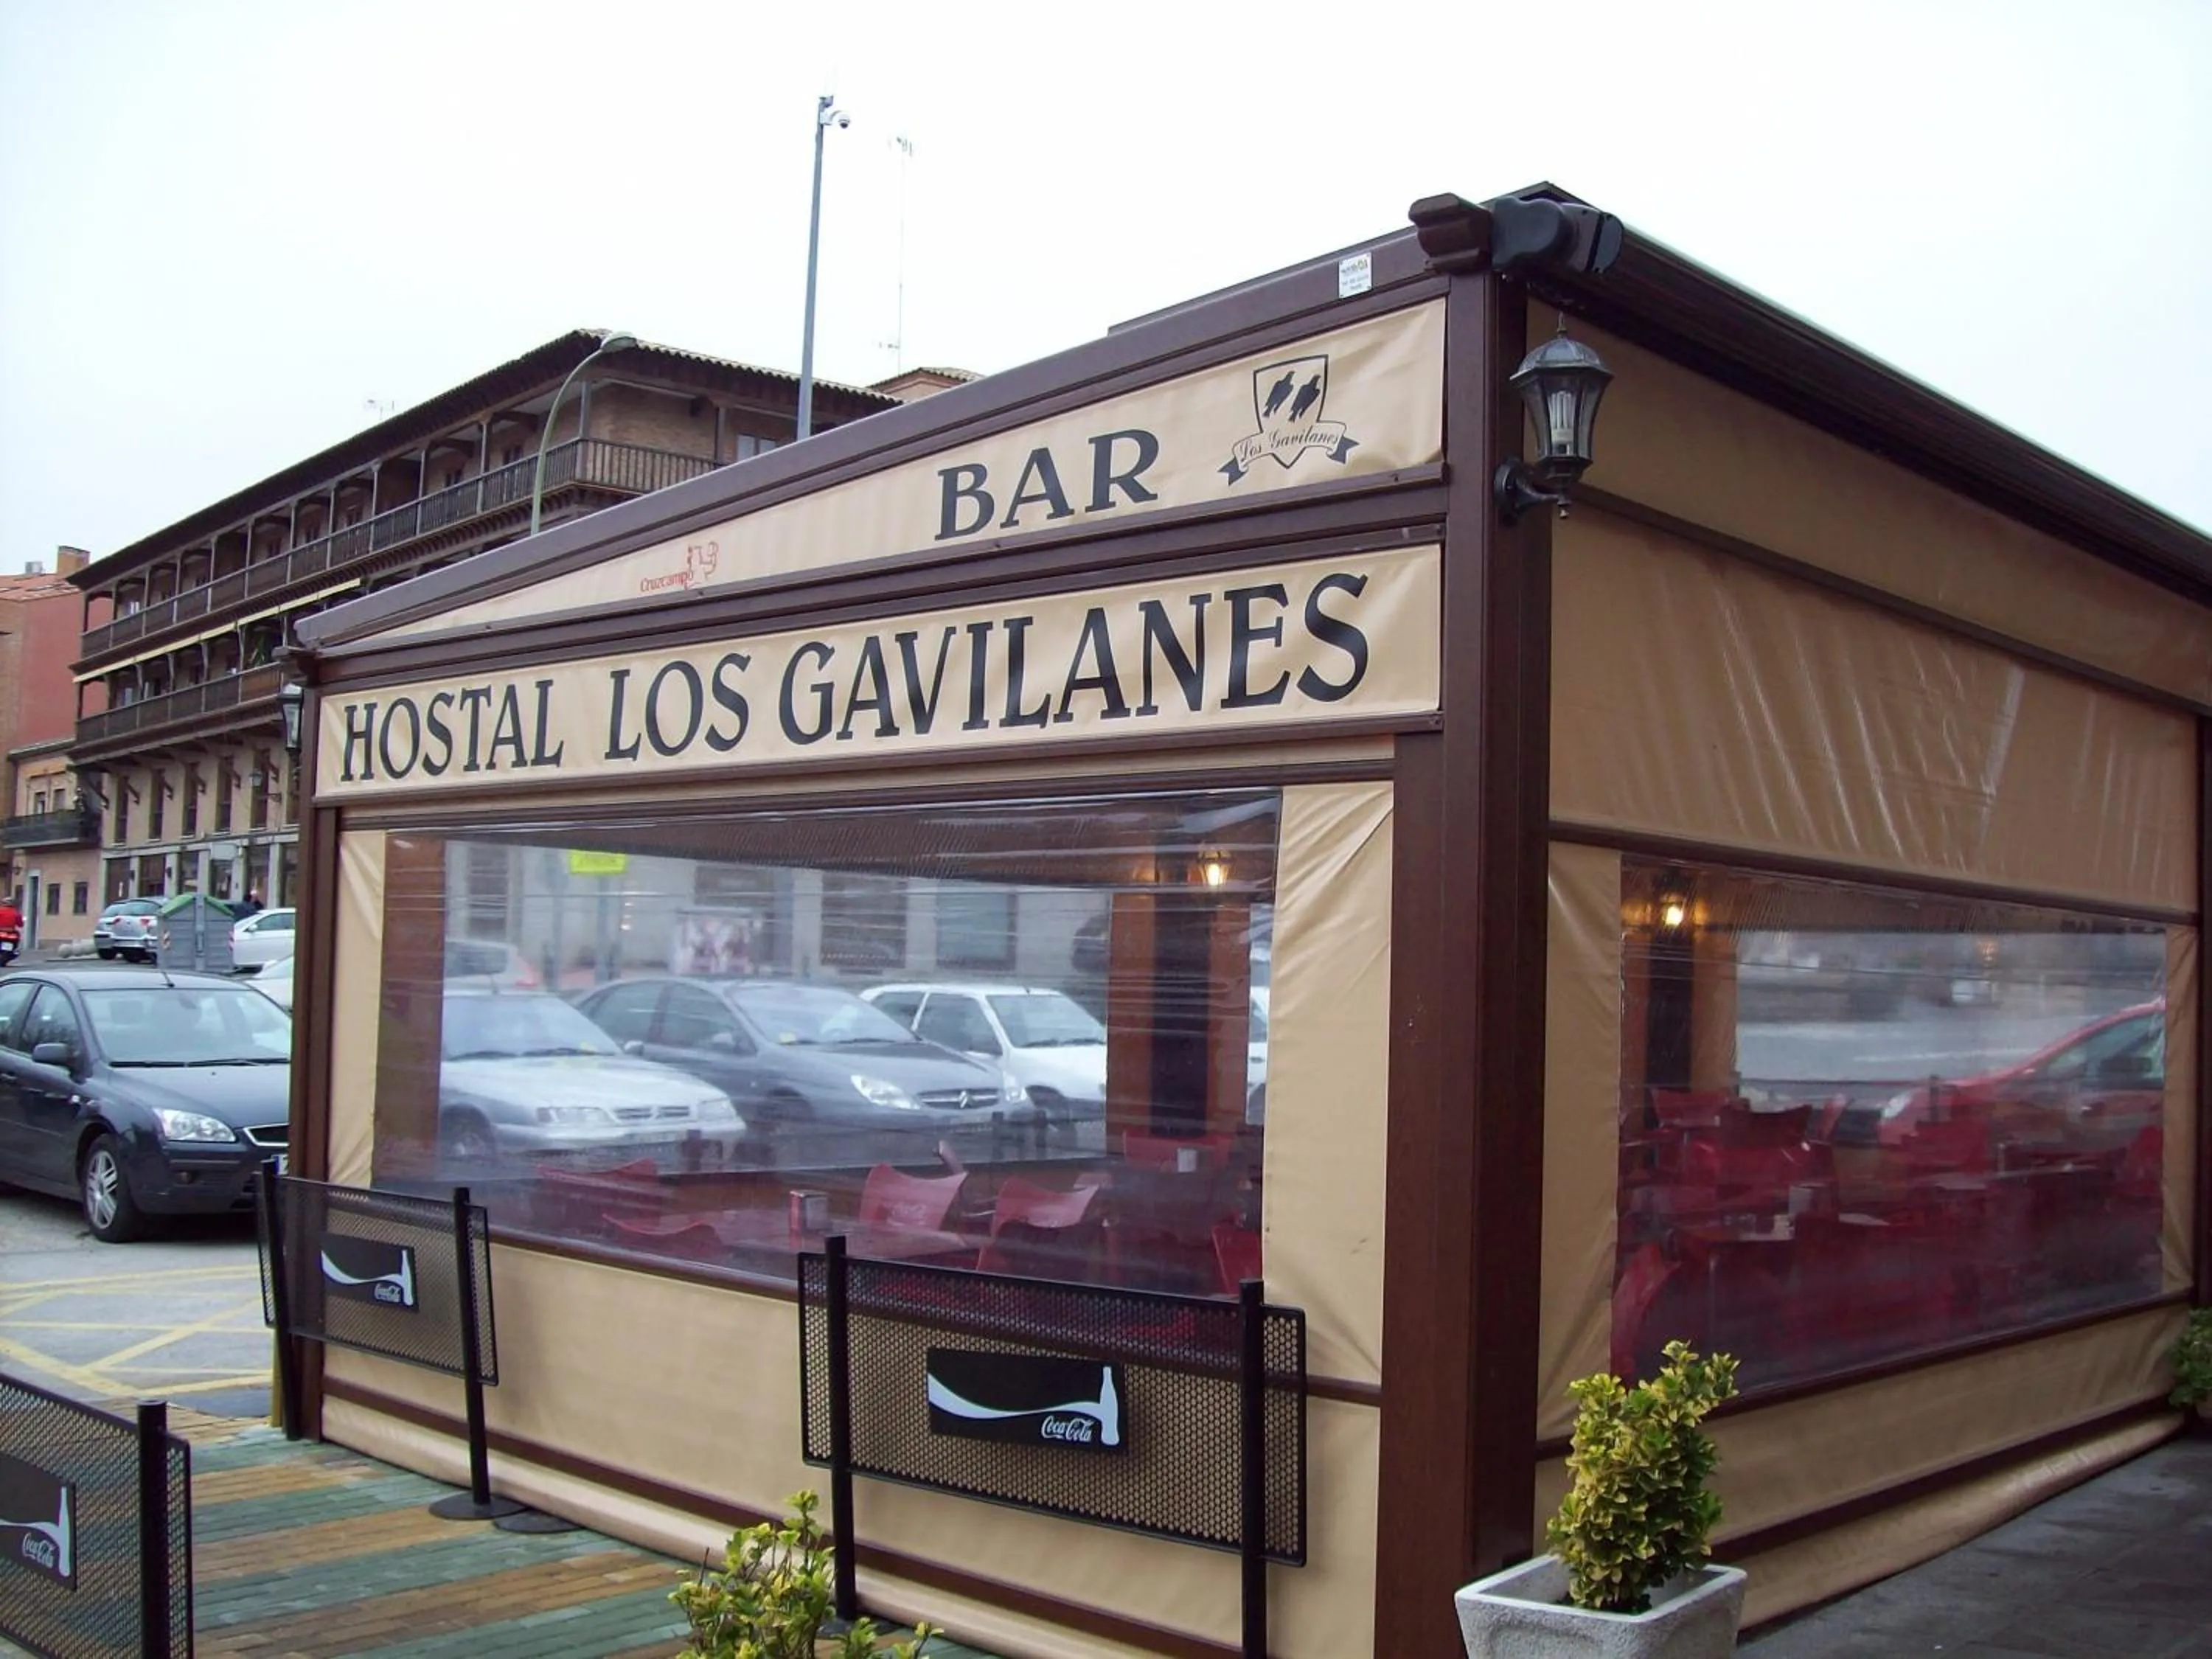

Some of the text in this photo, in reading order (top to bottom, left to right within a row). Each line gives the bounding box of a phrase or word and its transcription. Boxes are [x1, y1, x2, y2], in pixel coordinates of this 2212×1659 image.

[934, 429, 1159, 540] BAR
[1270, 425, 1339, 449] Gavilanes
[341, 573, 1368, 782] HOSTAL LOS GAVILANES
